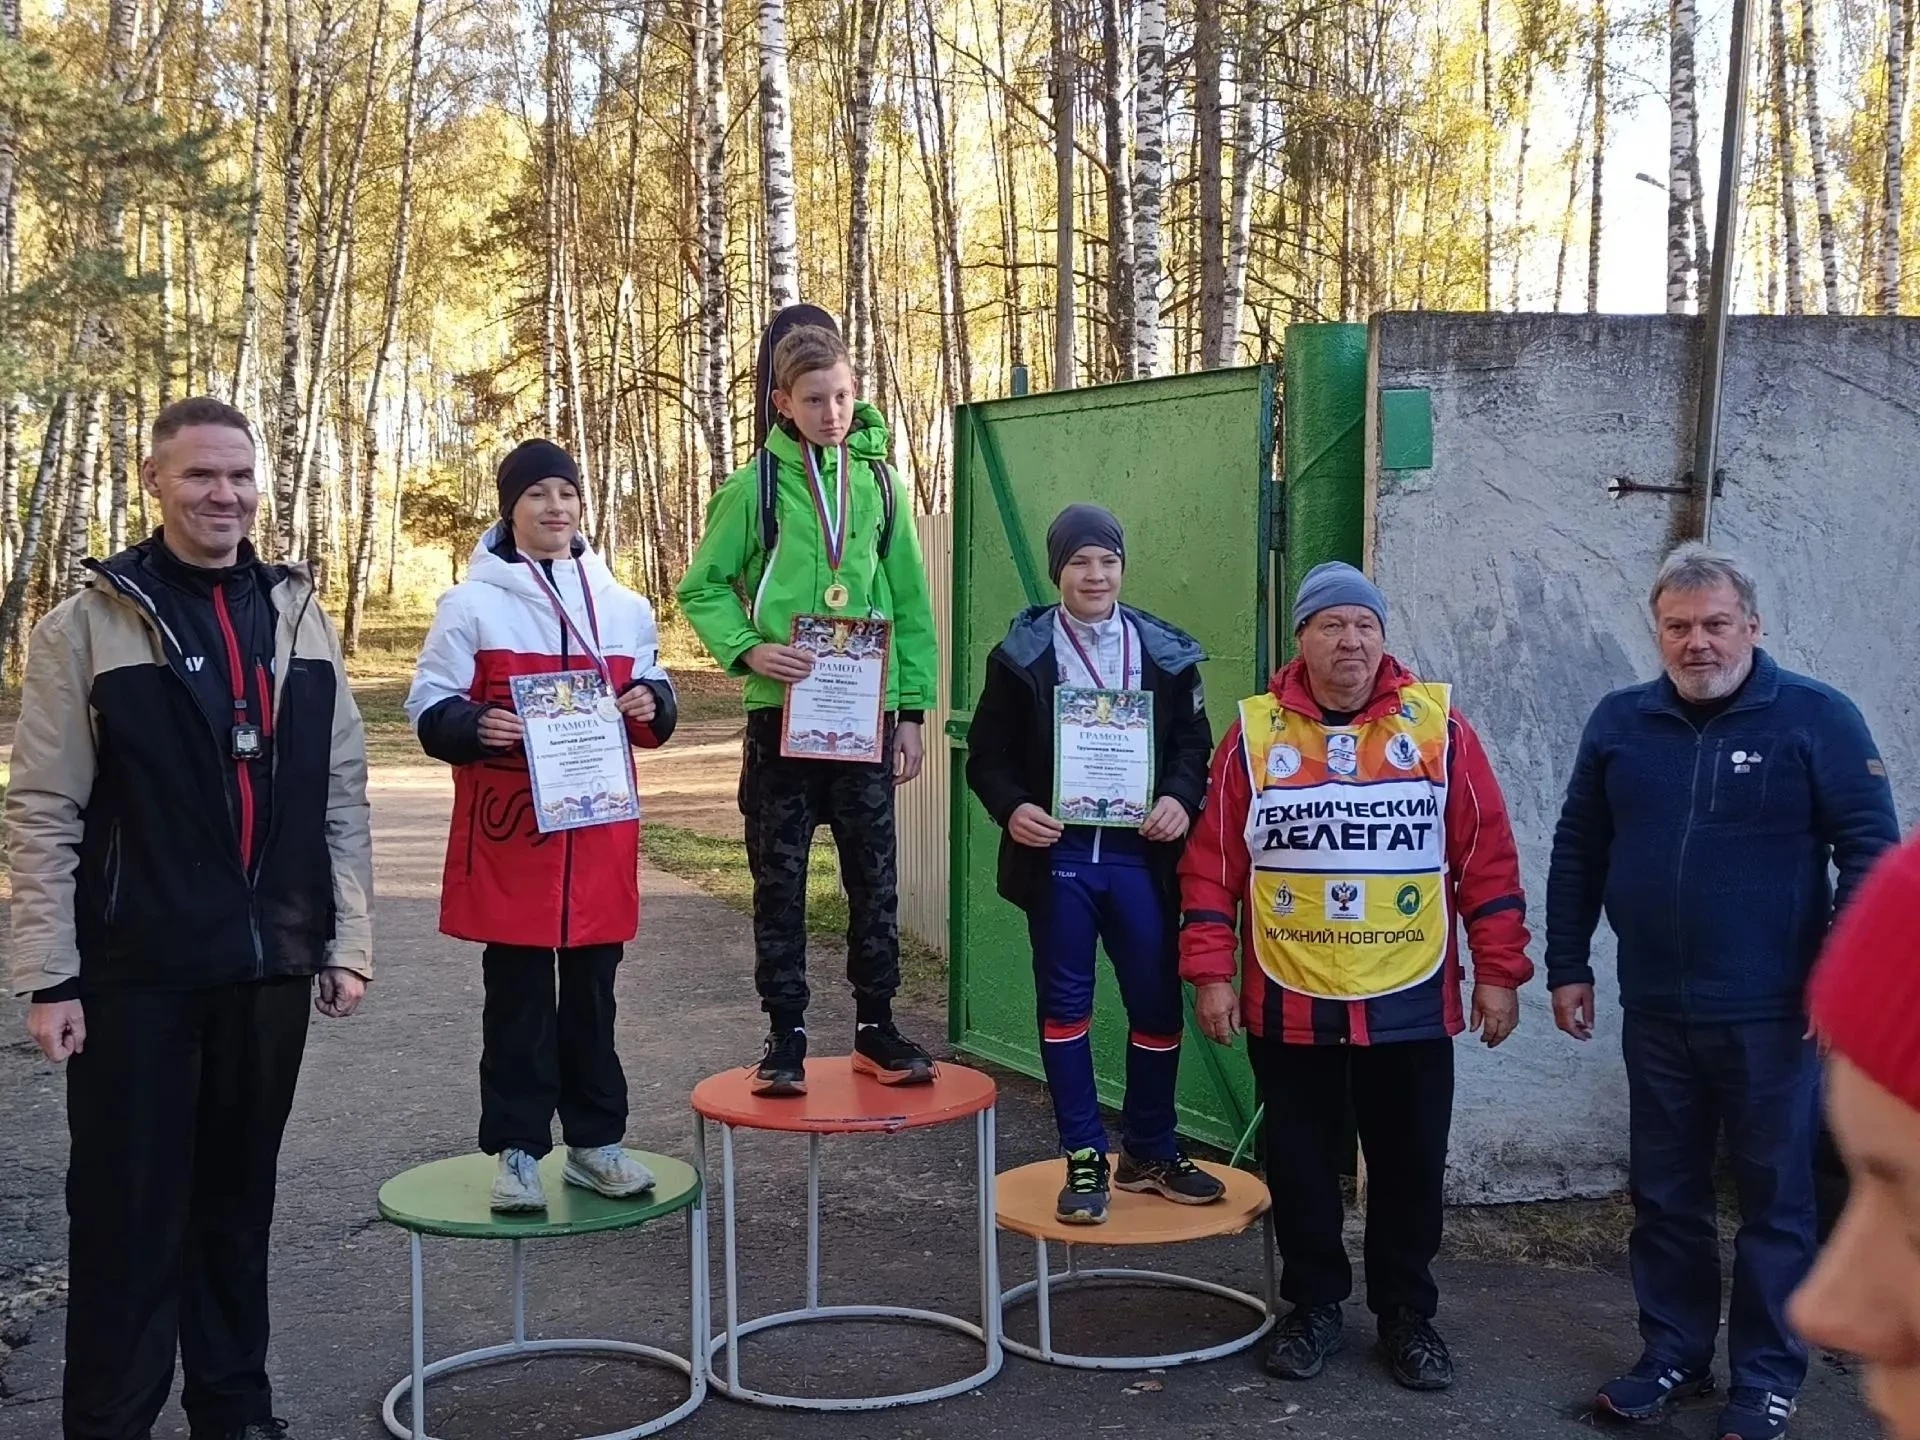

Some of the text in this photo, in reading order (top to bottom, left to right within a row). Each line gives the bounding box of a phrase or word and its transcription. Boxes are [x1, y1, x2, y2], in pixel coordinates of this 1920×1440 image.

[813, 662, 863, 673] ГРАМОТА
[547, 719, 600, 733] ГРАМОТА
[1079, 731, 1129, 741] ГРАМОТА
[1256, 795, 1438, 827] ТЕХНИЧЕСКИЙ
[1262, 822, 1433, 852] ДЕЛЕГАТ
[1265, 927, 1425, 944] НИЖНИЙ НОВГОРОД
